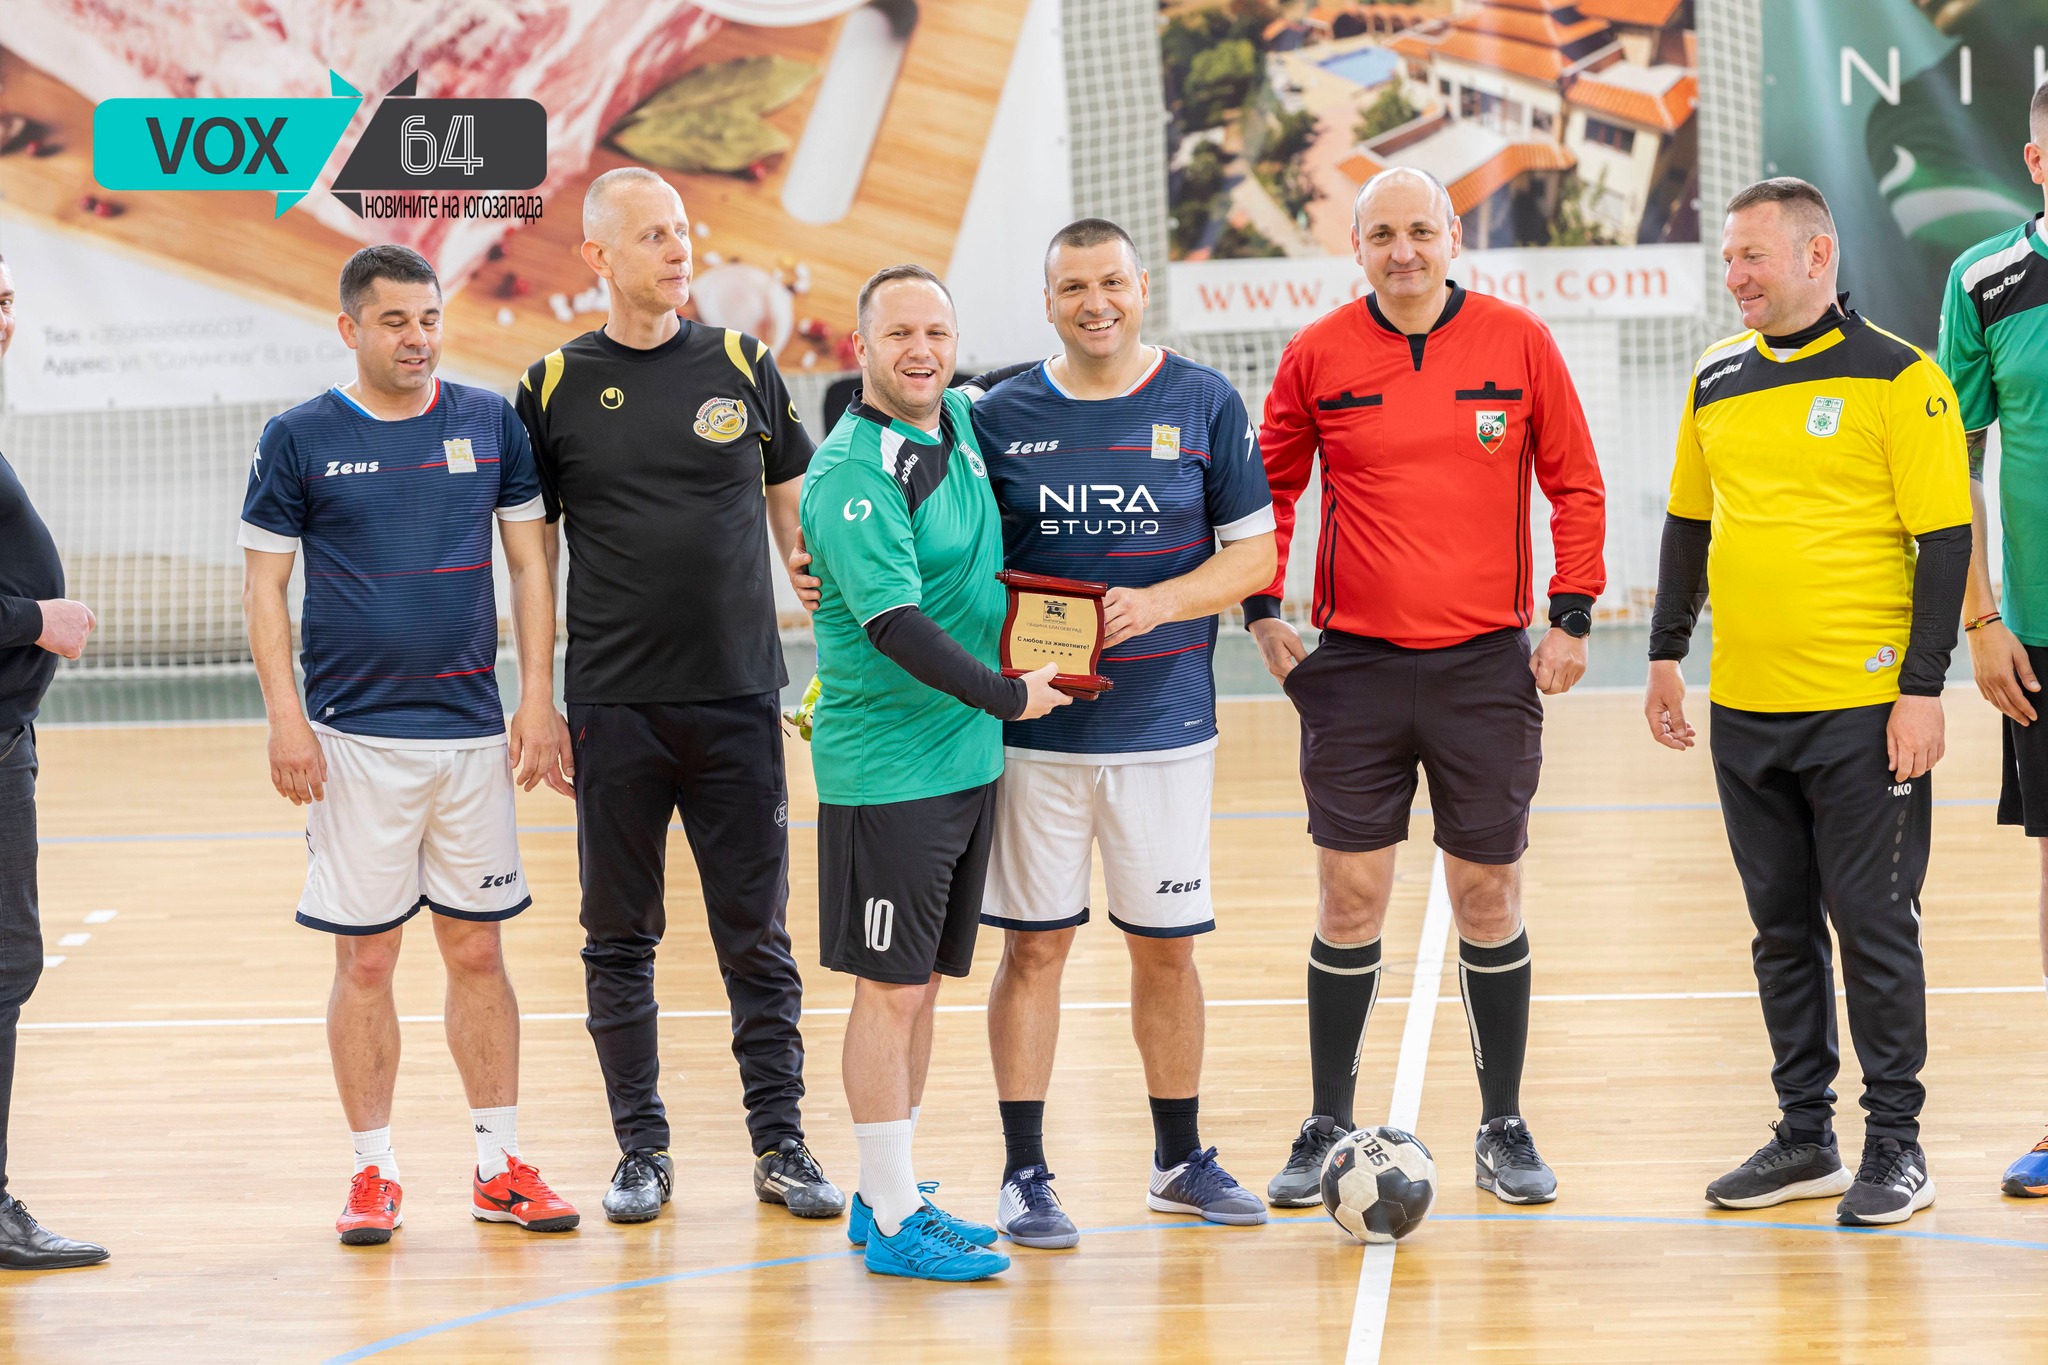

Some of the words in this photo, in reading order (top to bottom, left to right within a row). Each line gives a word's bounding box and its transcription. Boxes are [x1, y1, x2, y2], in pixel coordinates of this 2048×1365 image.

[1982, 269, 2027, 301] spotika
[1004, 439, 1060, 455] Zeus
[324, 461, 380, 477] Zeus
[1039, 484, 1160, 513] NIRA
[1040, 519, 1160, 535] STUDIO
[1053, 641, 1090, 650] животните!
[1887, 782, 1912, 797] AKO
[1156, 878, 1202, 894] Zeus
[864, 896, 895, 952] 10
[1019, 1169, 1035, 1177] LUNAR
